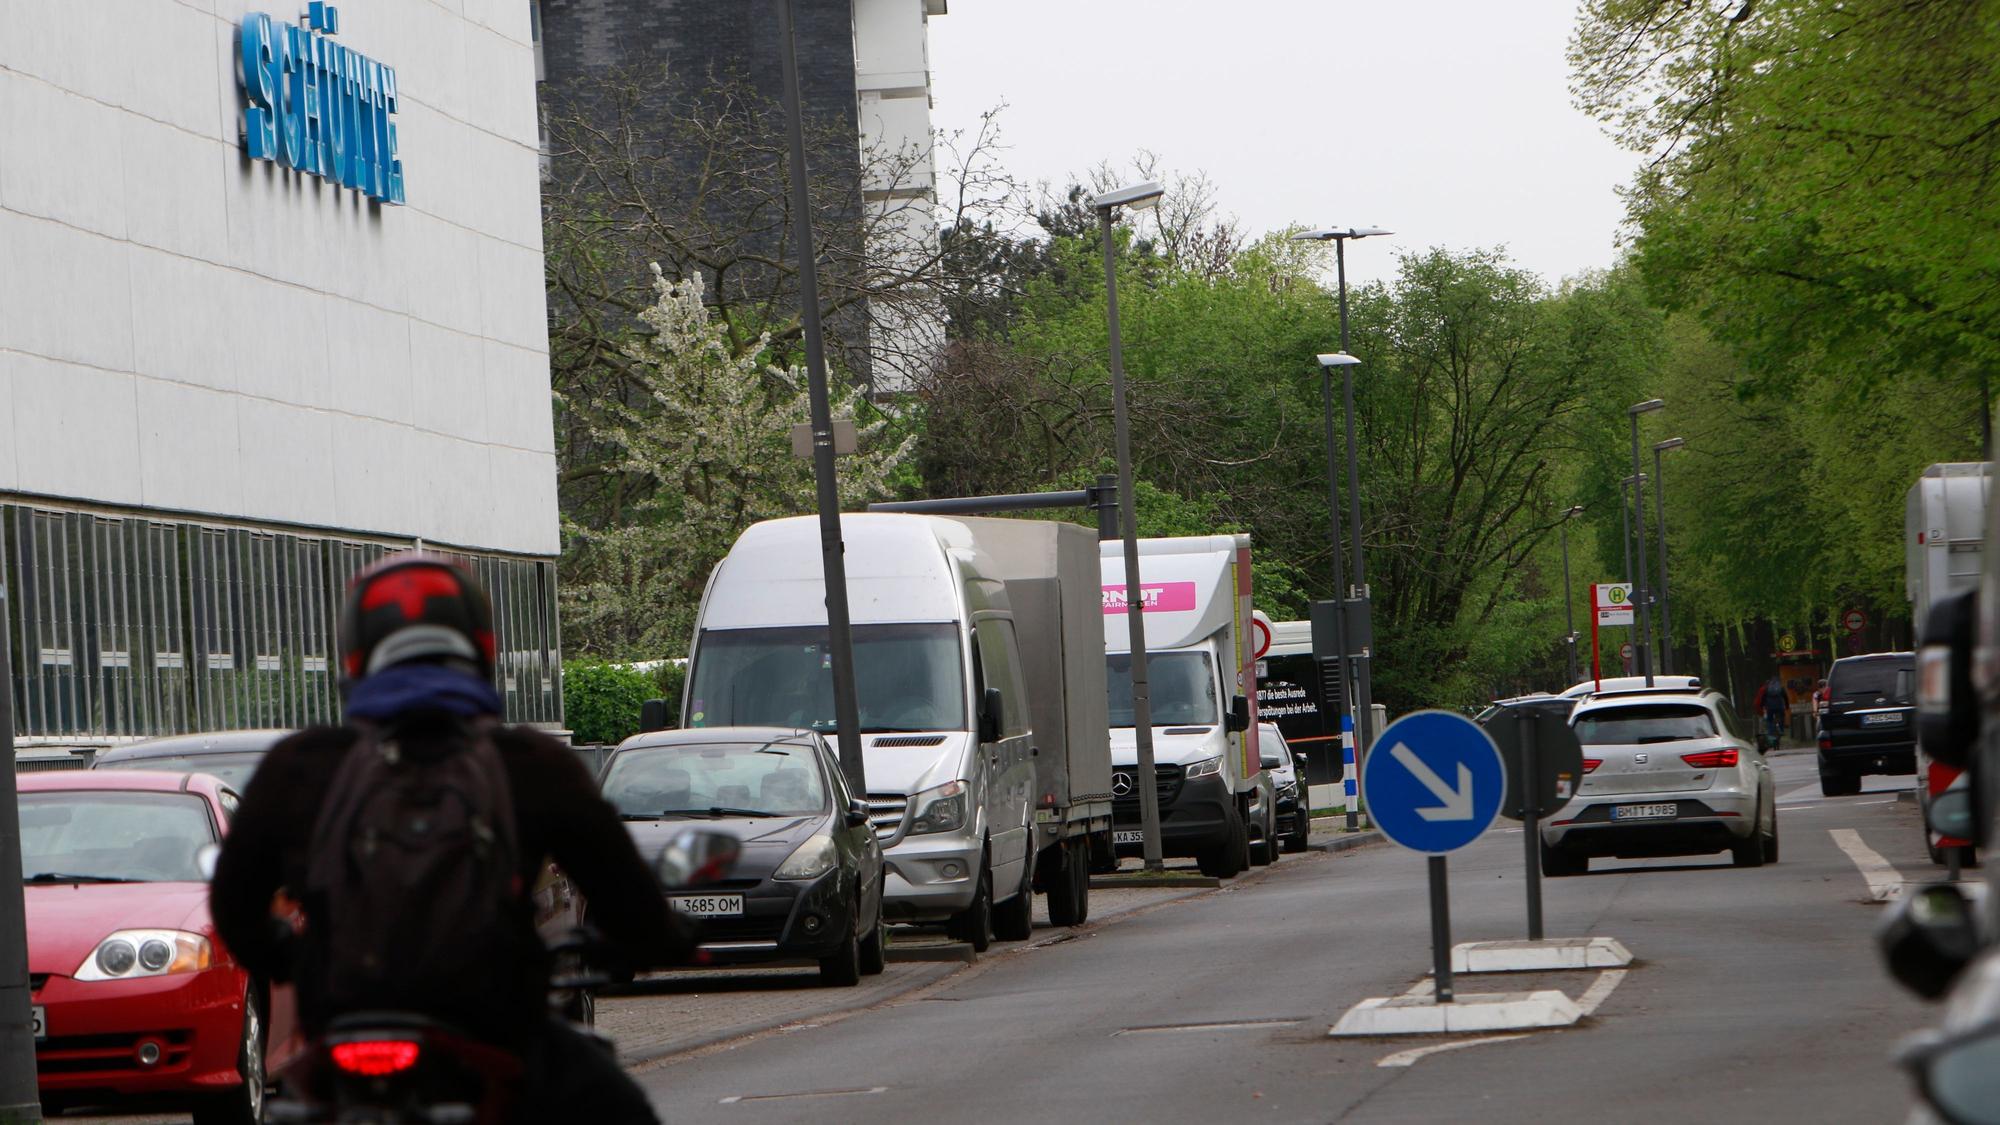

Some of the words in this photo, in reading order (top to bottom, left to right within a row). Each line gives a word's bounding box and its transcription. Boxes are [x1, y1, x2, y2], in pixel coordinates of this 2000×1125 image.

[241, 1, 405, 206] SCHÜTTE
[1274, 688, 1287, 700] beste
[1287, 686, 1306, 699] Ausrede
[1286, 703, 1294, 714] bei
[1648, 805, 1675, 815] 1985
[684, 899, 714, 912] 3685
[719, 898, 739, 911] OM
